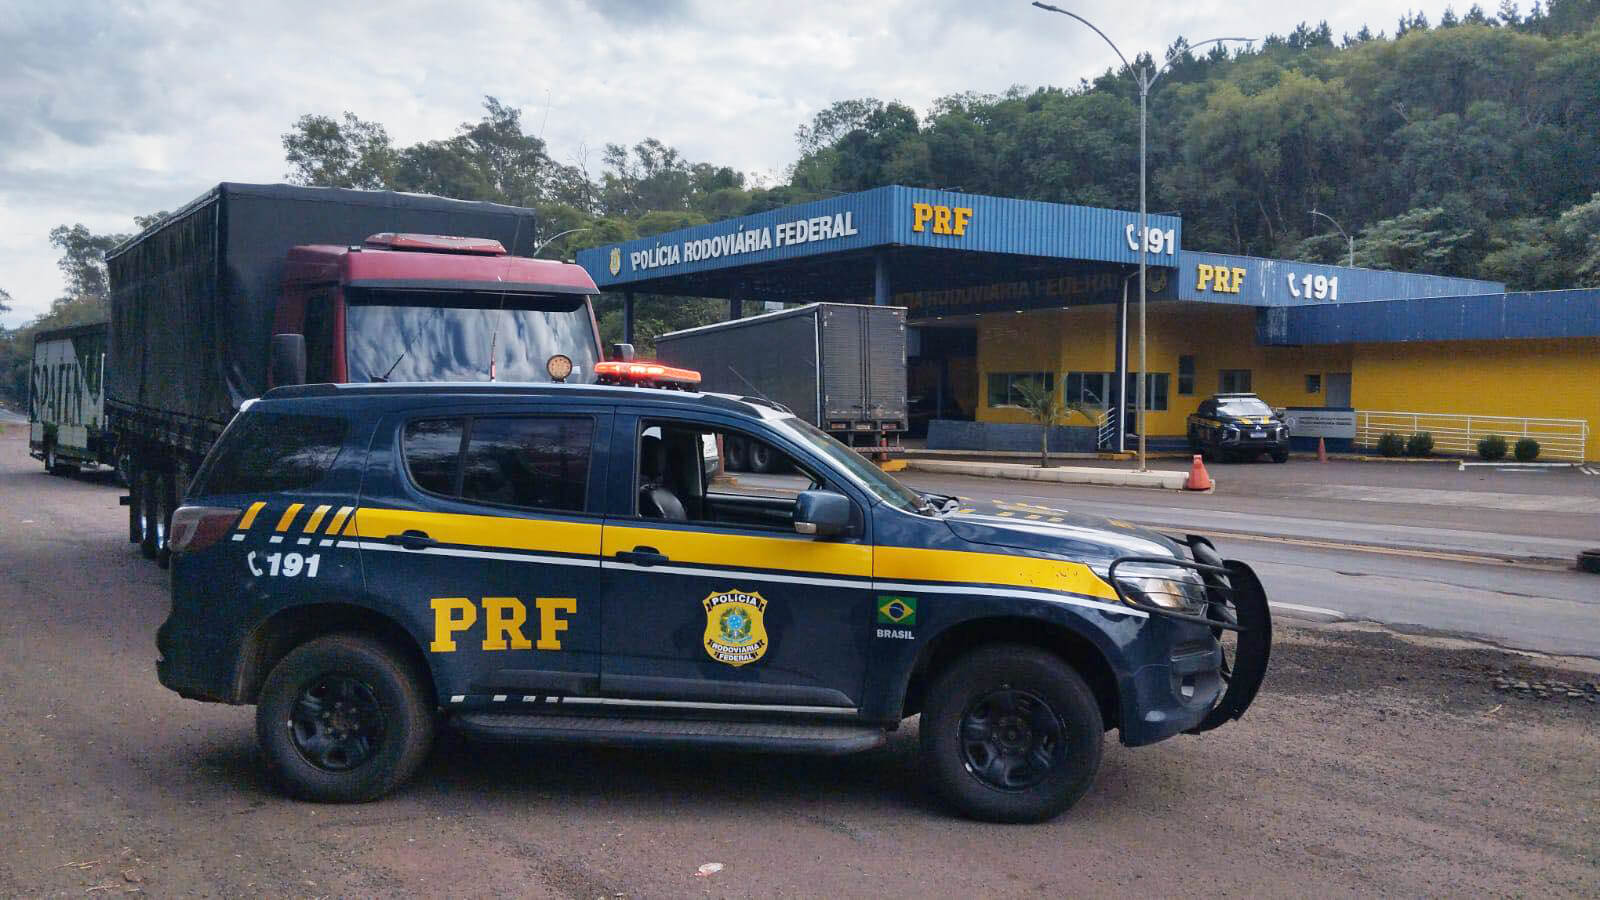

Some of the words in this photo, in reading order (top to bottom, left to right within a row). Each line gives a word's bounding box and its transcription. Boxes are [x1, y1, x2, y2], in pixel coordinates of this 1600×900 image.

[912, 203, 973, 236] PRF
[631, 241, 680, 271] POLÍCIA
[684, 225, 772, 262] RODOVIÁRIA
[776, 212, 858, 247] FEDERAL
[1138, 226, 1175, 255] 191
[1197, 264, 1247, 293] PRF
[1302, 274, 1338, 300] 191
[266, 552, 321, 578] 191
[430, 597, 577, 653] PRF
[876, 629, 915, 640] BRASIL
[719, 653, 754, 662] FEDERAL
